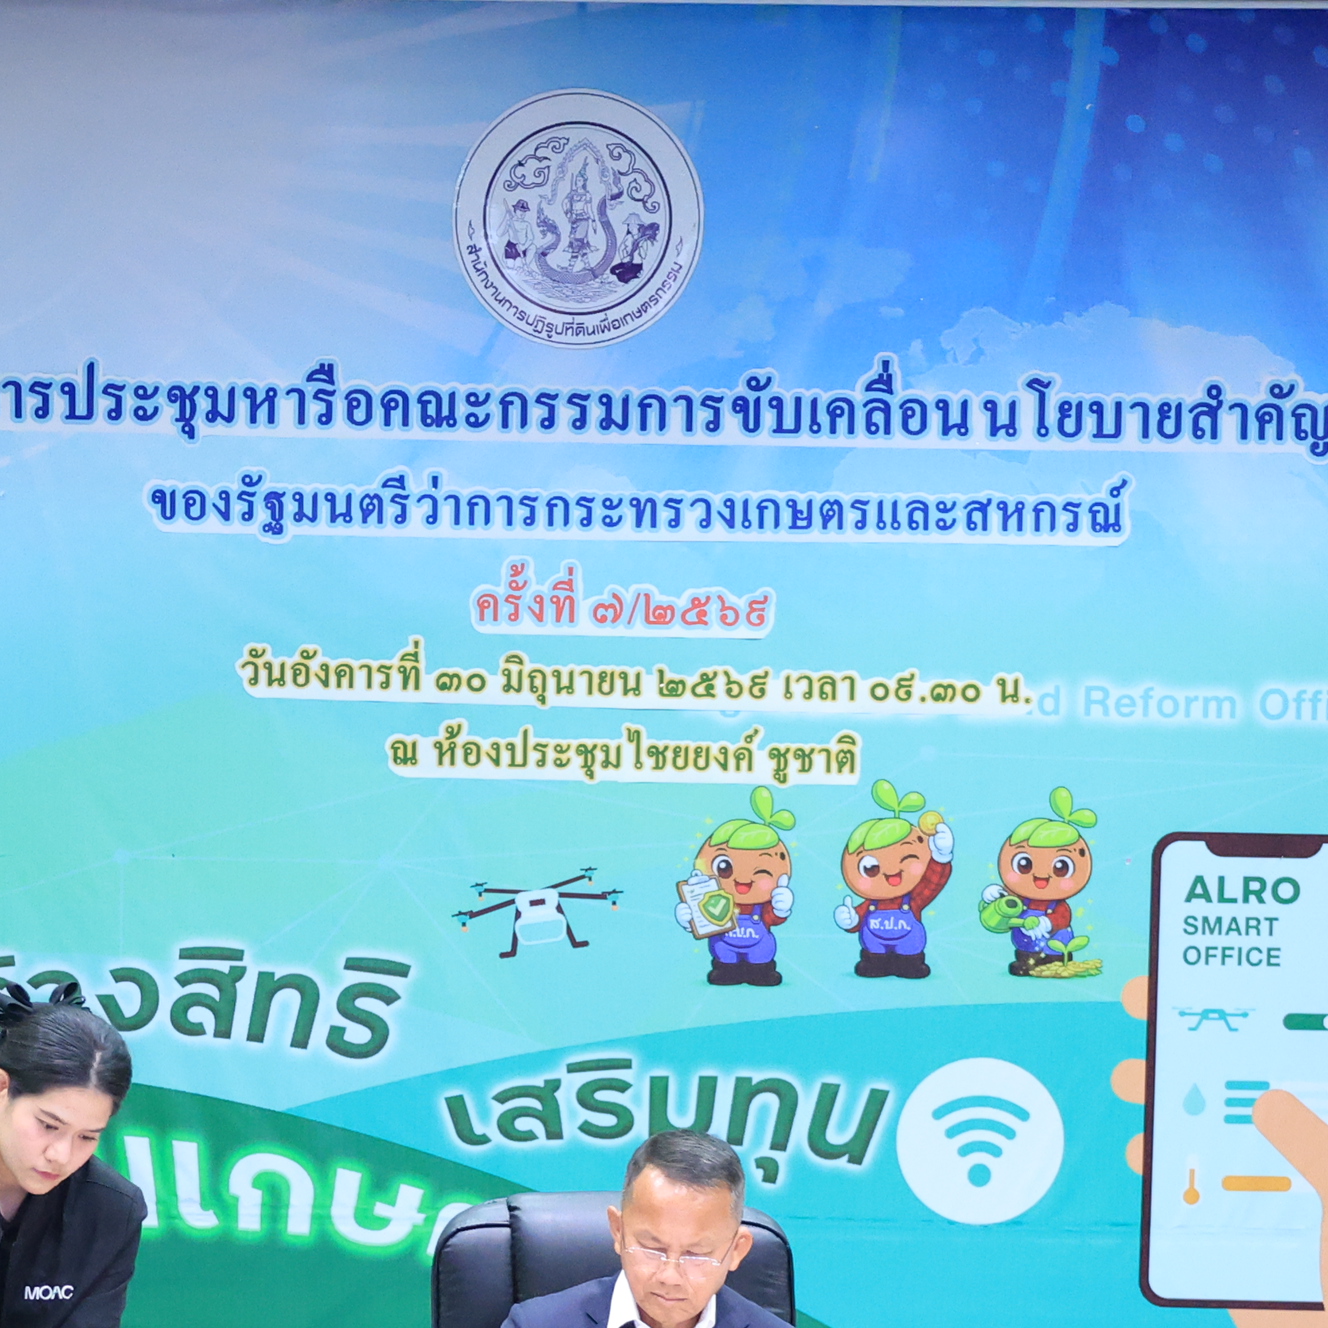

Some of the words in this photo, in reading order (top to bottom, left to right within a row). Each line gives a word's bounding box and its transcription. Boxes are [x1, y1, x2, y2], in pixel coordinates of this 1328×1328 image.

[466, 243, 683, 339] สำนักงานการปฏิรูปที่ดินเพื่อเกษตรกรรม
[151, 473, 1128, 535] ของรัฐมนตรีว่าการกระทรวงเกษตรและสหกรณ์
[476, 562, 576, 623] ครั้งที่
[241, 640, 420, 691] วันอังคารที่
[435, 671, 487, 692] ๓๐
[501, 654, 641, 706] มิถุนายน
[784, 673, 857, 702] เวลา
[996, 675, 1034, 704] น.
[1083, 685, 1238, 720] Reform
[389, 739, 418, 766] ณ
[768, 736, 857, 784] ชูชาติ
[1183, 874, 1301, 905] ALRO
[868, 916, 912, 931] ส.ป.ก.
[1183, 915, 1280, 937] SMART
[1182, 945, 1281, 967] OFFICE
[444, 1057, 891, 1185] เสริมทุน
[24, 1284, 75, 1300] MOAC
